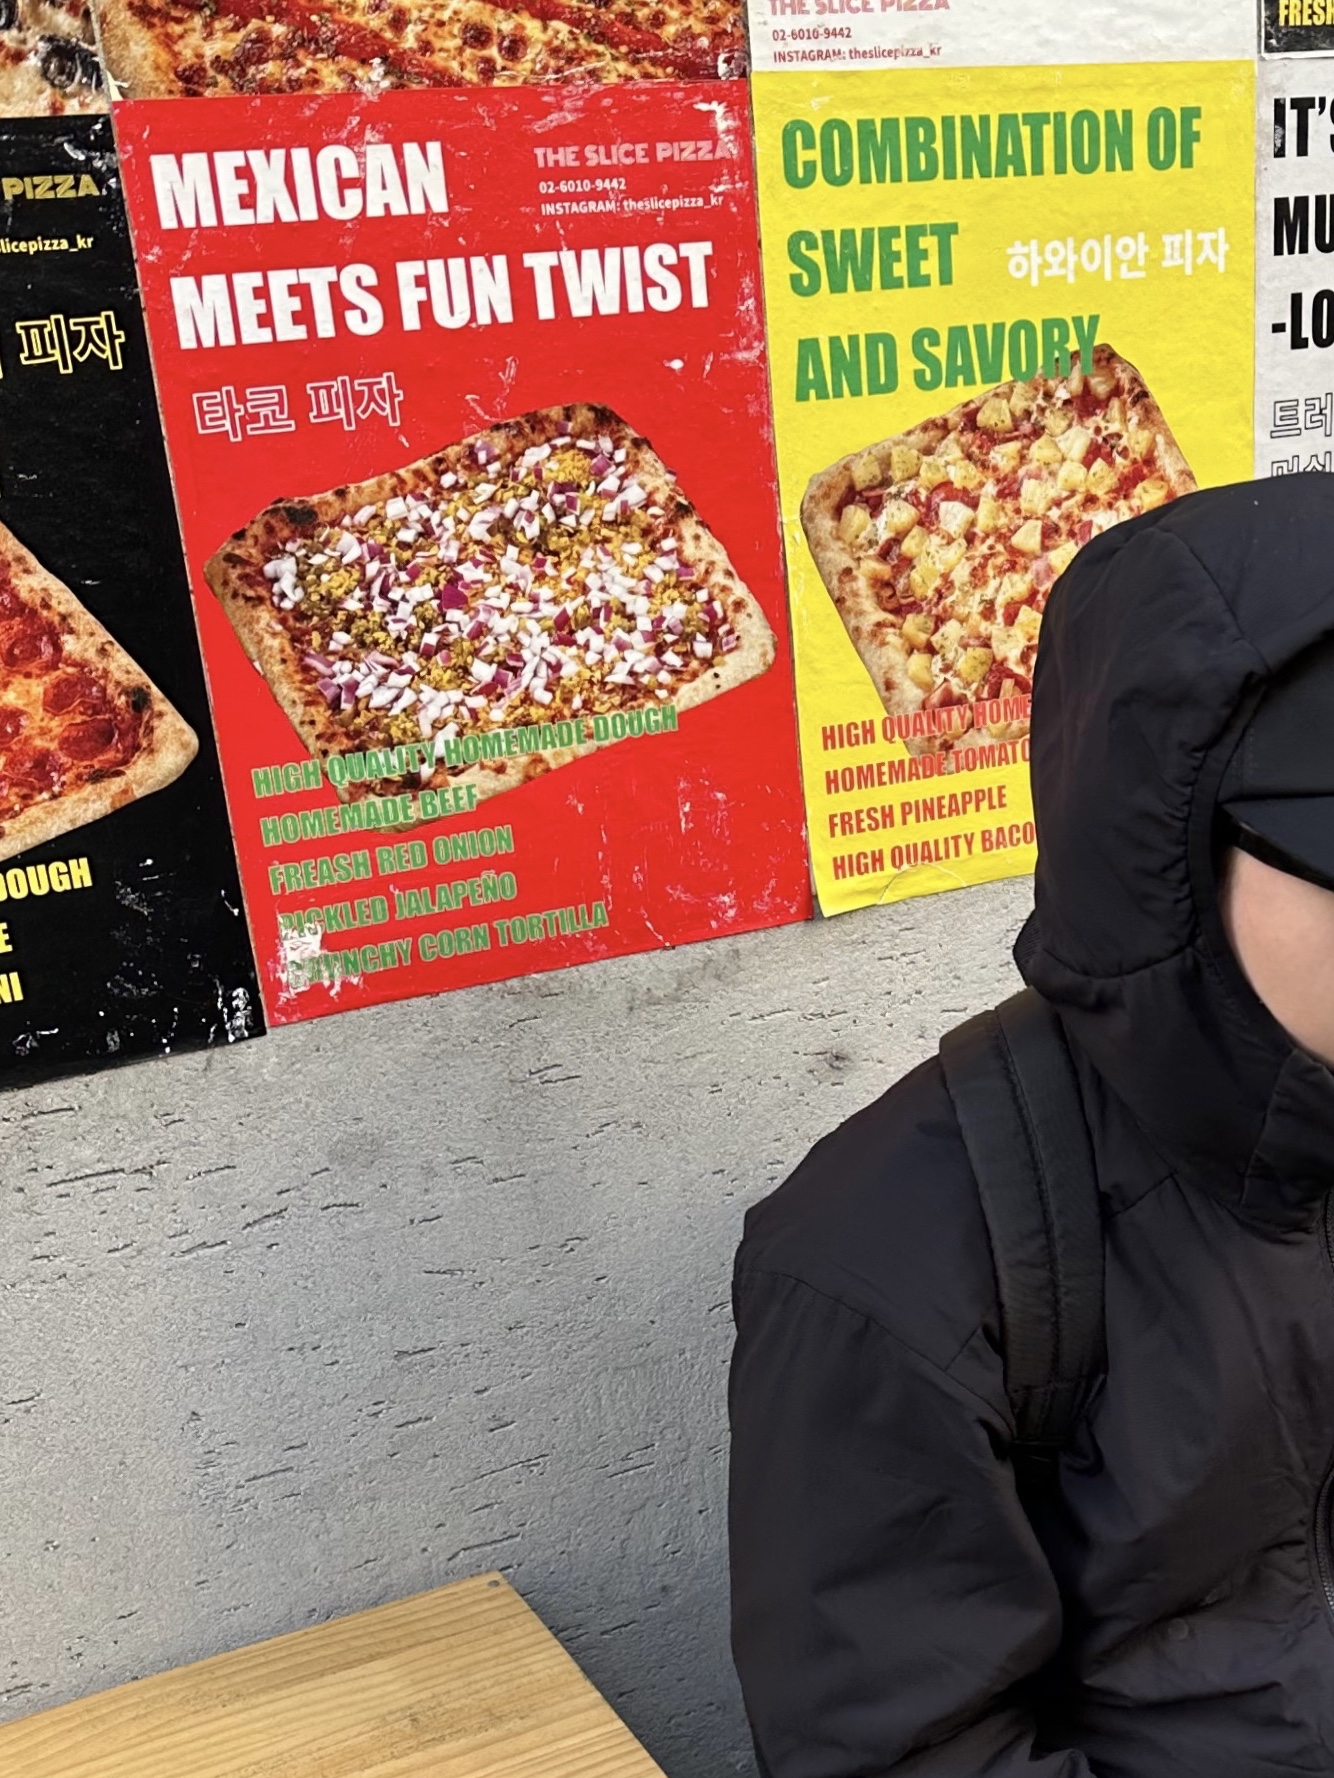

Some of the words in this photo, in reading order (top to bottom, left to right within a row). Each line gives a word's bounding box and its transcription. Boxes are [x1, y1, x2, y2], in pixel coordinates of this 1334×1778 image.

[772, 27, 852, 42] 02-6010-9442
[533, 146, 580, 168] THE
[584, 142, 650, 167] SLICE
[655, 140, 737, 162] PIZZA
[781, 109, 1134, 189] COMBINATION
[1146, 106, 1202, 170] OF
[2, 174, 100, 200] PIZZA
[150, 141, 449, 230] MEXICAN
[538, 177, 627, 195] 02-6010-9442
[541, 200, 621, 216] INSTAGRAM:
[623, 194, 724, 213] theslicepizza_kr
[0, 235, 94, 255] licepizza_kr
[787, 222, 959, 297] SWEET
[1006, 232, 1150, 287] 하와이안
[1161, 228, 1230, 276] 피자
[169, 263, 384, 349] MEETS
[395, 254, 513, 332] FUN
[522, 241, 713, 319] TWIST
[15, 311, 126, 374] 피자
[795, 331, 898, 402] AND
[912, 314, 1100, 392] SAVORY
[192, 385, 296, 442] 타코
[306, 371, 404, 431] 피자
[251, 759, 322, 798] HIGH
[327, 742, 437, 789] QUALITY
[443, 718, 586, 767] HOMEMADE
[593, 704, 680, 743] DOUGH
[822, 719, 875, 751] HIGH
[882, 703, 969, 743] QUALITY
[973, 694, 1031, 728] HOME
[825, 753, 946, 795] HOMEMADE
[260, 793, 416, 848] HOMEMADE
[418, 784, 479, 818] BEEF
[828, 805, 895, 838] FRESH
[901, 785, 1007, 826] PINEAPPLE
[268, 850, 372, 896] FREASH
[377, 840, 429, 875] RED
[433, 824, 515, 862] ONION
[832, 849, 884, 880] HIGH
[890, 832, 975, 871] QUALITY
[981, 821, 1035, 854] BACO
[394, 869, 518, 920] JALAPEÑO
[418, 921, 491, 962] CORN
[493, 901, 610, 947] TORTILLA
